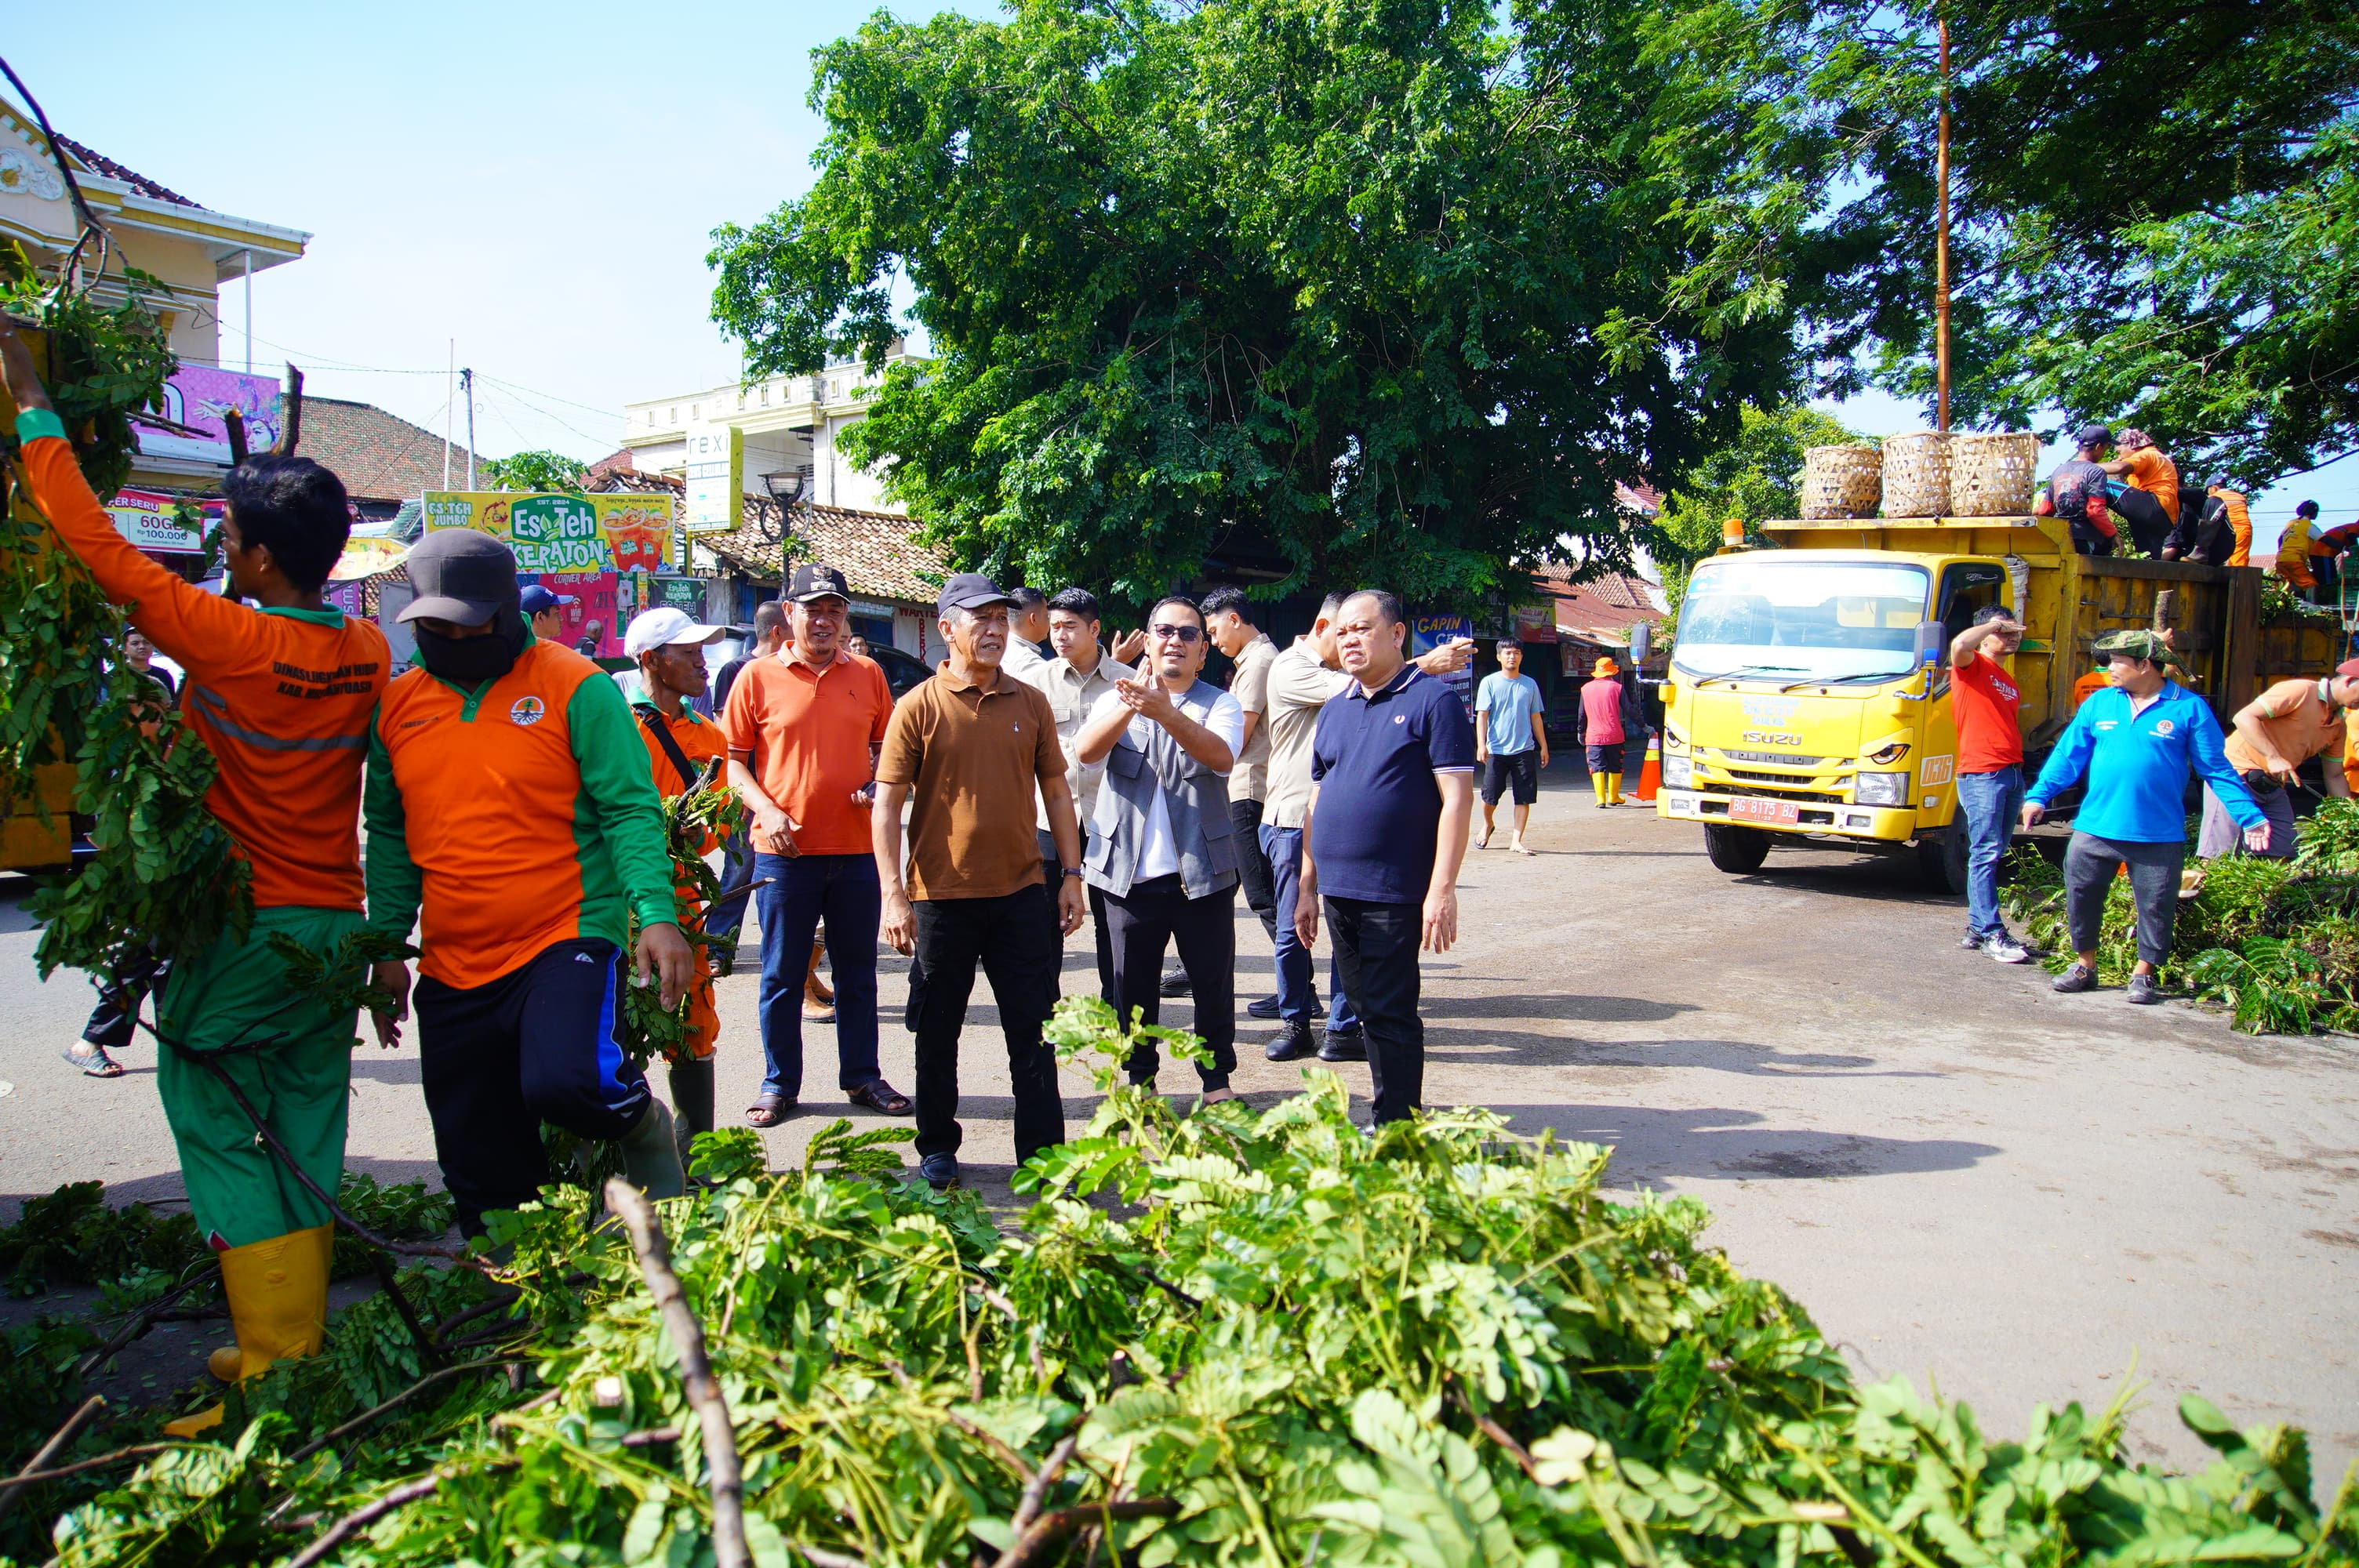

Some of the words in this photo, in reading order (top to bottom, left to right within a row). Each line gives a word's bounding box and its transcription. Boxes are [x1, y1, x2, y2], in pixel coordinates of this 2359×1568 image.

[130, 498, 158, 512] SERU
[434, 514, 467, 526] JUMBO
[514, 509, 540, 538] Es
[554, 507, 594, 538] Teh
[506, 540, 604, 573] KERATON
[554, 574, 581, 585] CORNER
[583, 572, 602, 583] AREA
[899, 607, 940, 619] WARTE
[1417, 617, 1461, 633] GAPIN
[1743, 731, 1801, 746] ISUZU
[1922, 756, 1952, 784] 036
[1733, 799, 1746, 811] BG
[1750, 800, 1776, 815] 8175
[1782, 804, 1796, 818] BZ
